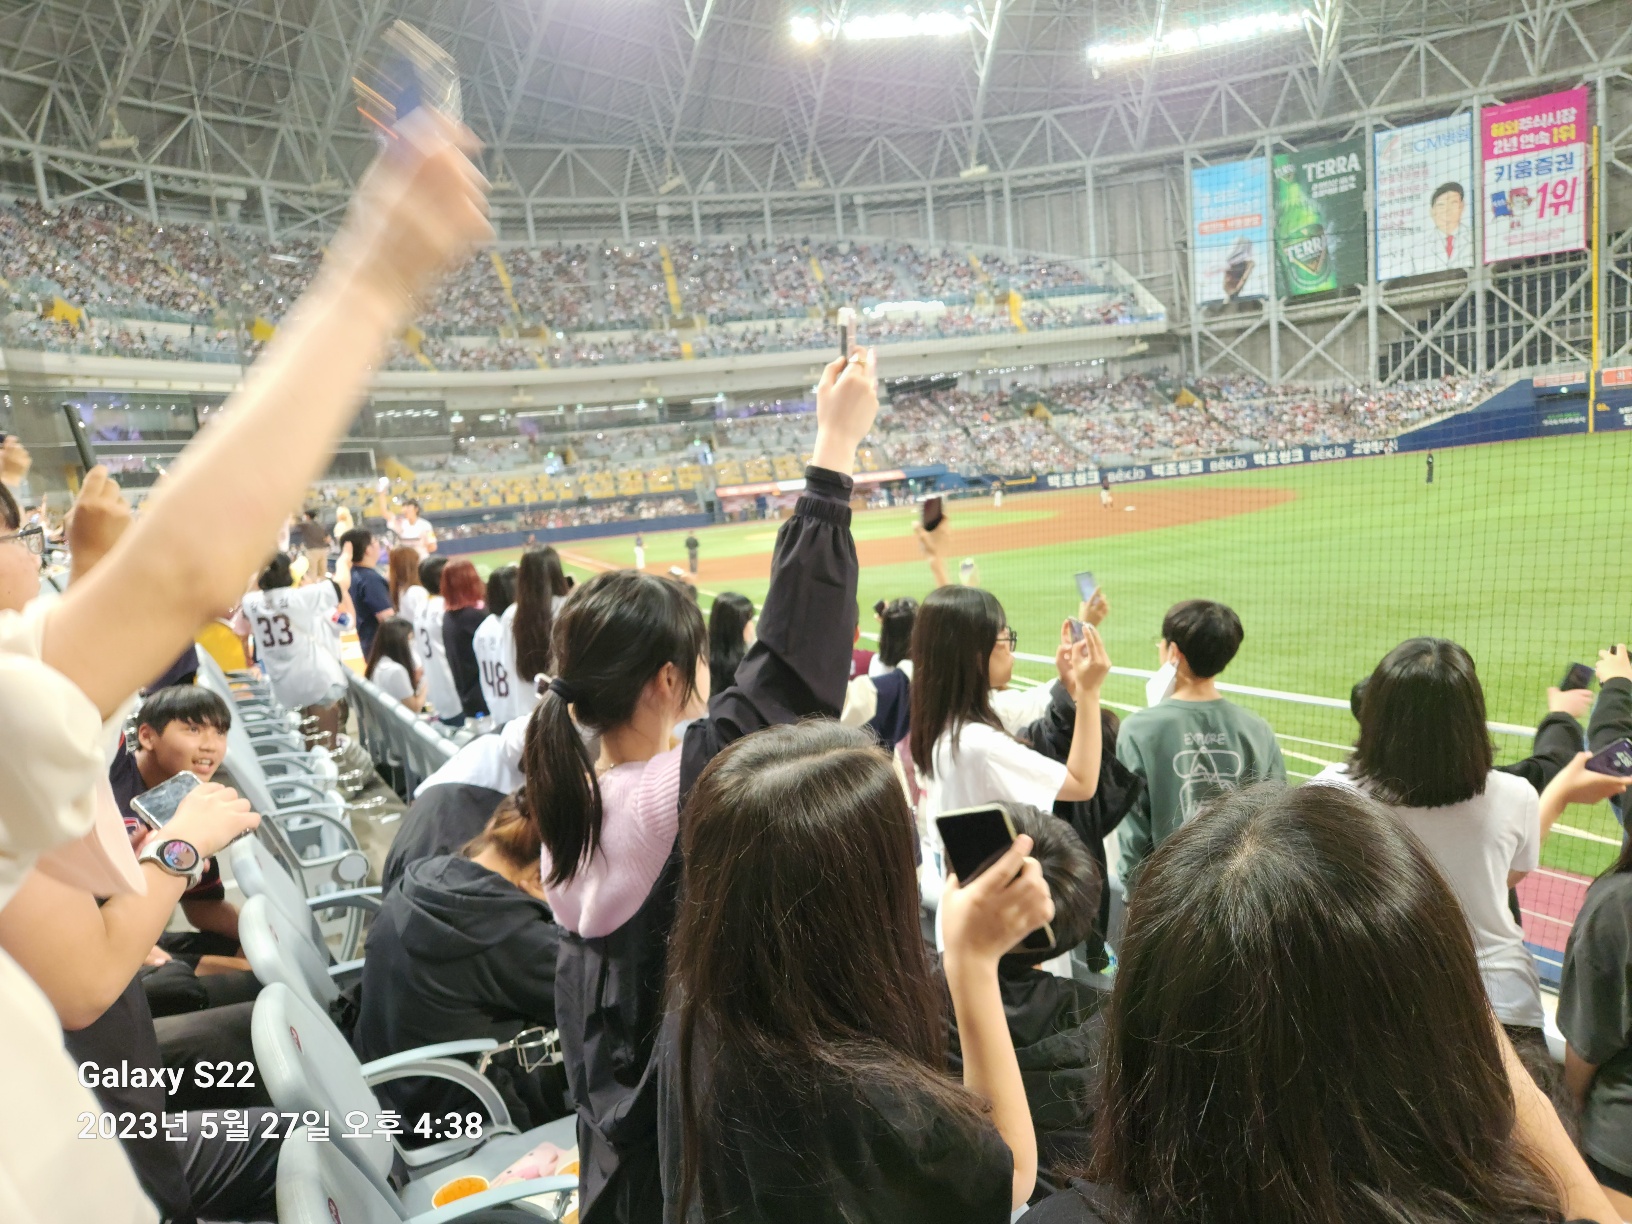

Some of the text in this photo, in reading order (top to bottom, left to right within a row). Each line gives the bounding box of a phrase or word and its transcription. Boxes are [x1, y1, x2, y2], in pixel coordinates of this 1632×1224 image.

[1552, 123, 1576, 144] 1위
[1301, 152, 1362, 183] TERRA
[1495, 151, 1574, 183] 키움증권
[1537, 176, 1578, 219] 1위
[257, 614, 294, 648] 33
[482, 660, 510, 698] 48
